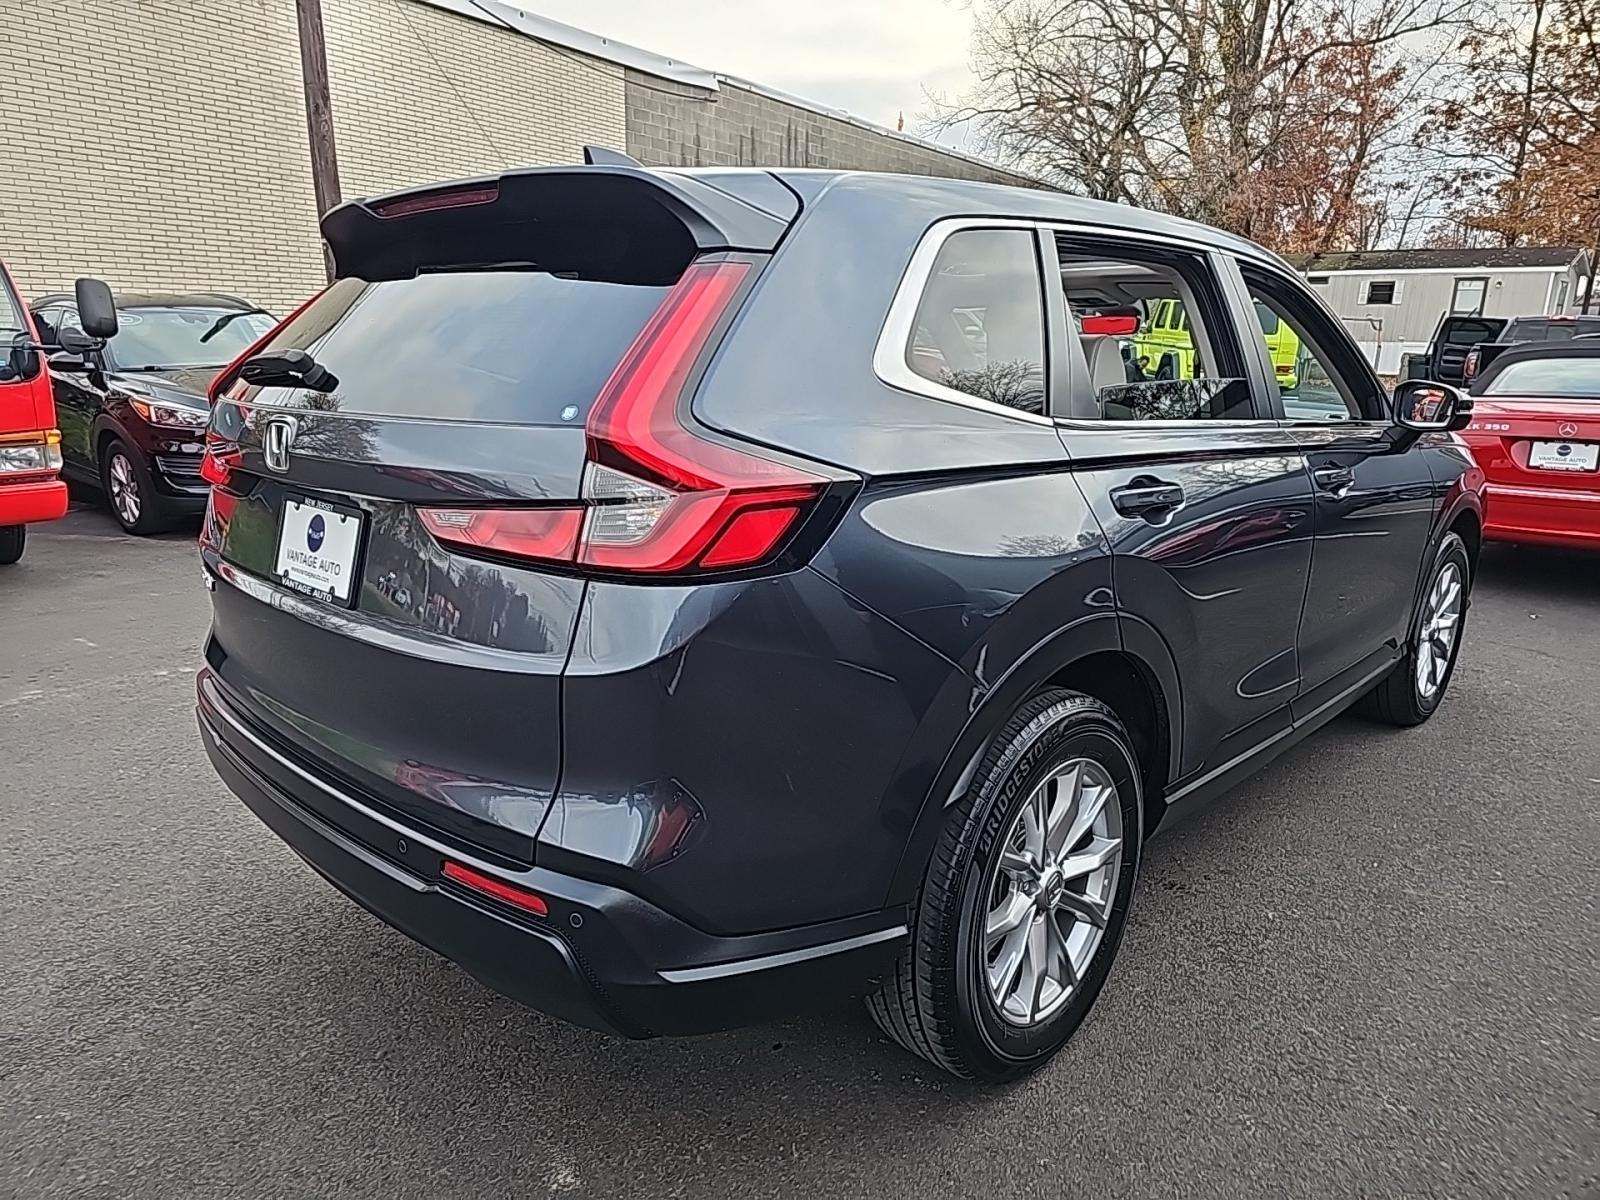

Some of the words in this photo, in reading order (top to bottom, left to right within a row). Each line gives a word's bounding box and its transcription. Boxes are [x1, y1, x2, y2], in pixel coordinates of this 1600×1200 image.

[1484, 423, 1510, 431] 350
[305, 496, 315, 507] NEW
[315, 500, 335, 512] JERSEY
[287, 547, 318, 569] VANTAGE
[319, 559, 341, 576] AUTO
[282, 577, 312, 594] VANTAGE
[312, 589, 333, 602] AUTO
